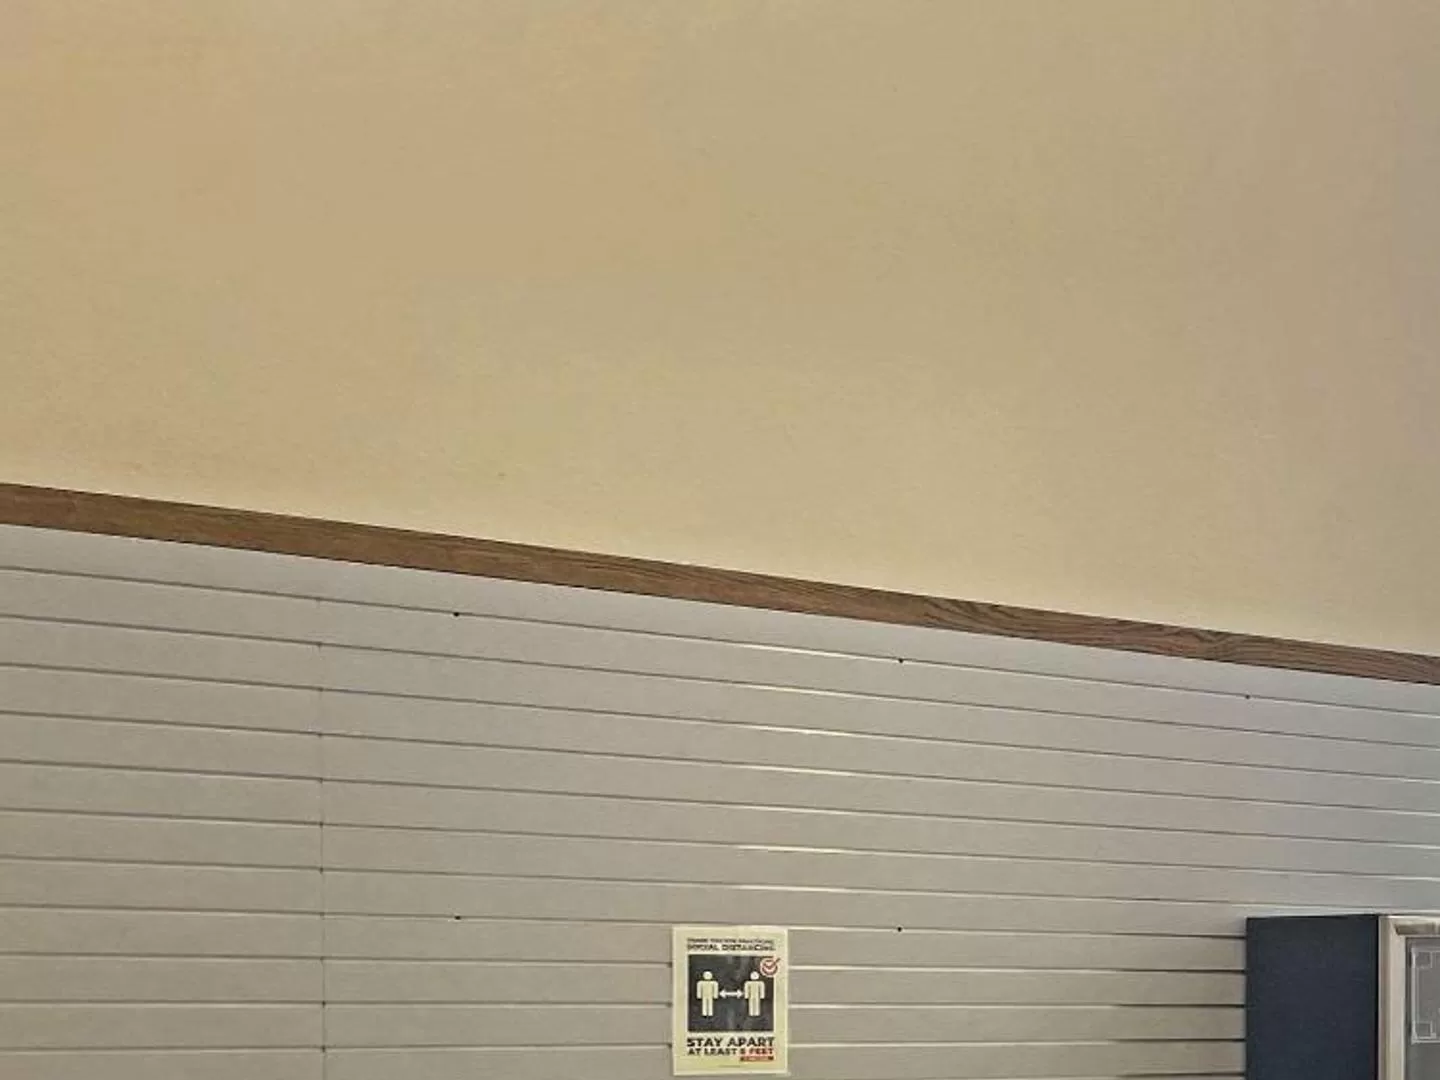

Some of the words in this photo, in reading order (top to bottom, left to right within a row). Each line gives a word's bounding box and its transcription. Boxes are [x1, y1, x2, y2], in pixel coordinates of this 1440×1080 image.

[686, 1037, 722, 1047] STAY
[727, 1036, 775, 1047] APART
[687, 1048, 701, 1056] AT
[703, 1048, 737, 1056] LEAST
[748, 1047, 774, 1055] FEET
